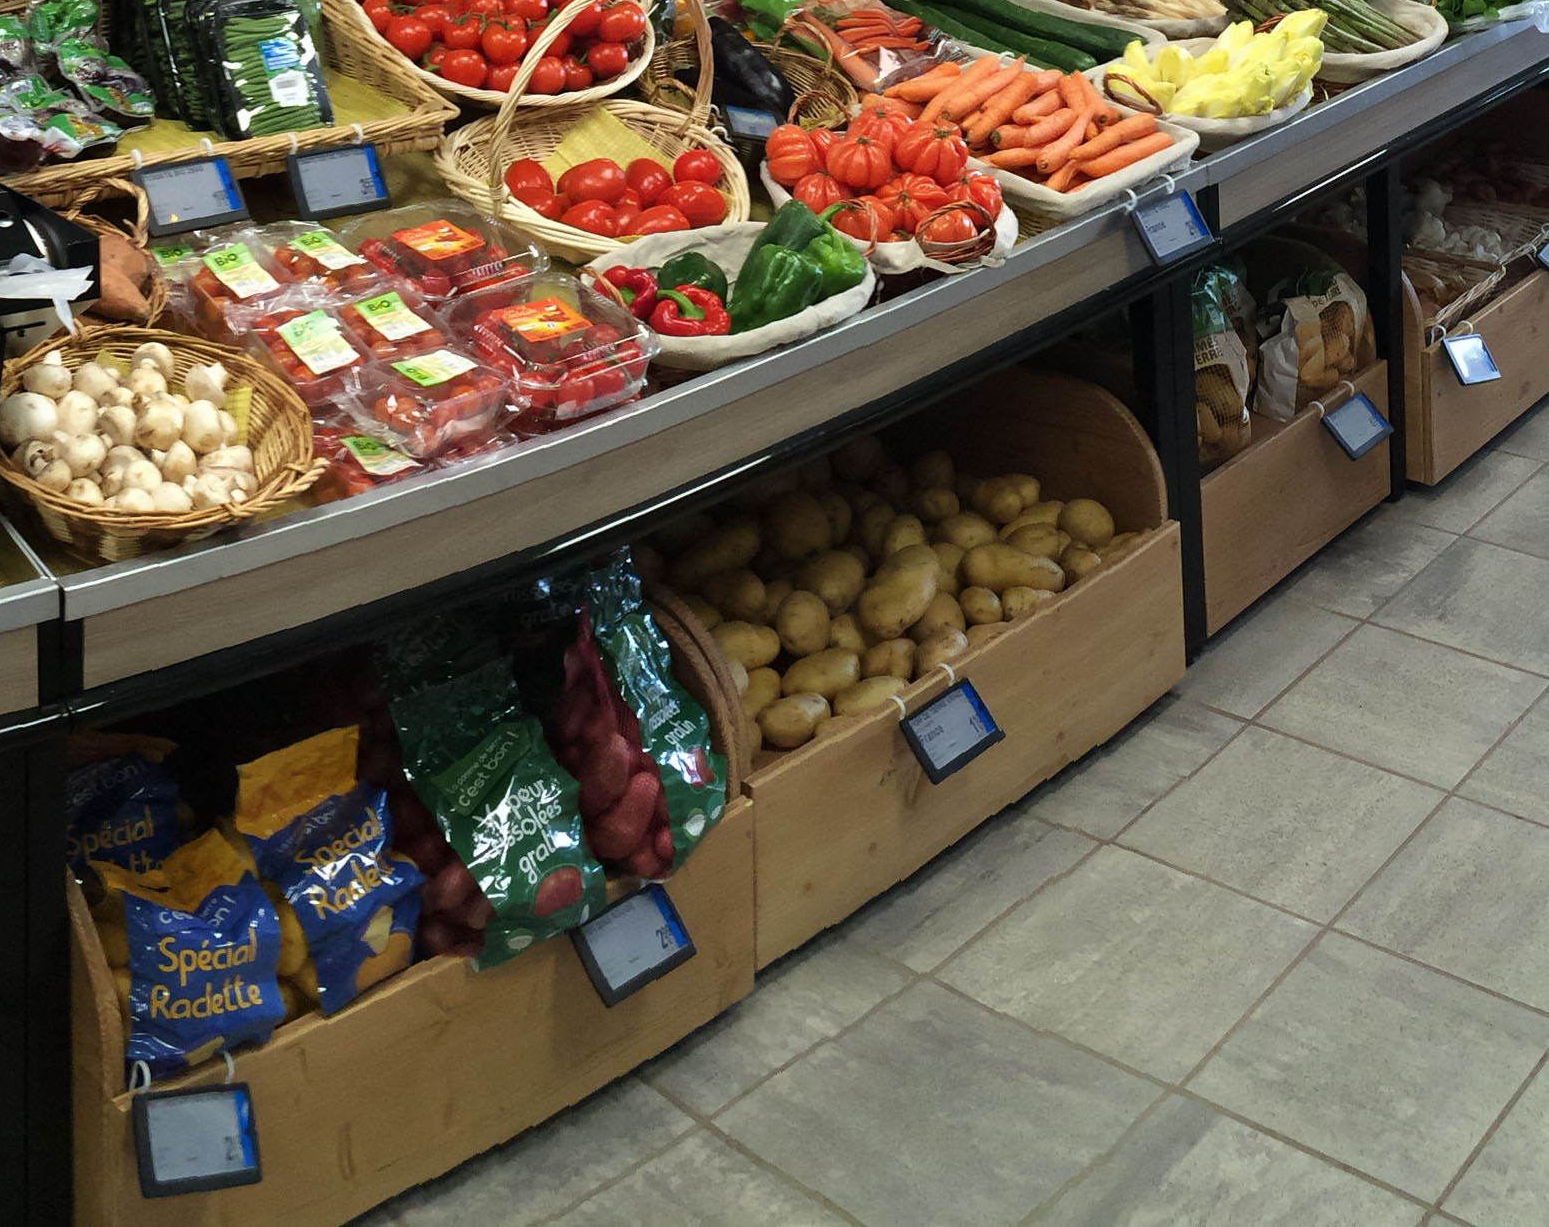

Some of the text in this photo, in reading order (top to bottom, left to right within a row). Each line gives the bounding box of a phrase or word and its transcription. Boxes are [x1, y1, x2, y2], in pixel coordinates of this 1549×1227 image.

[459, 770, 491, 807] c'est
[482, 741, 514, 771] bon
[67, 805, 154, 863] Spécial
[159, 927, 257, 987] Spécial
